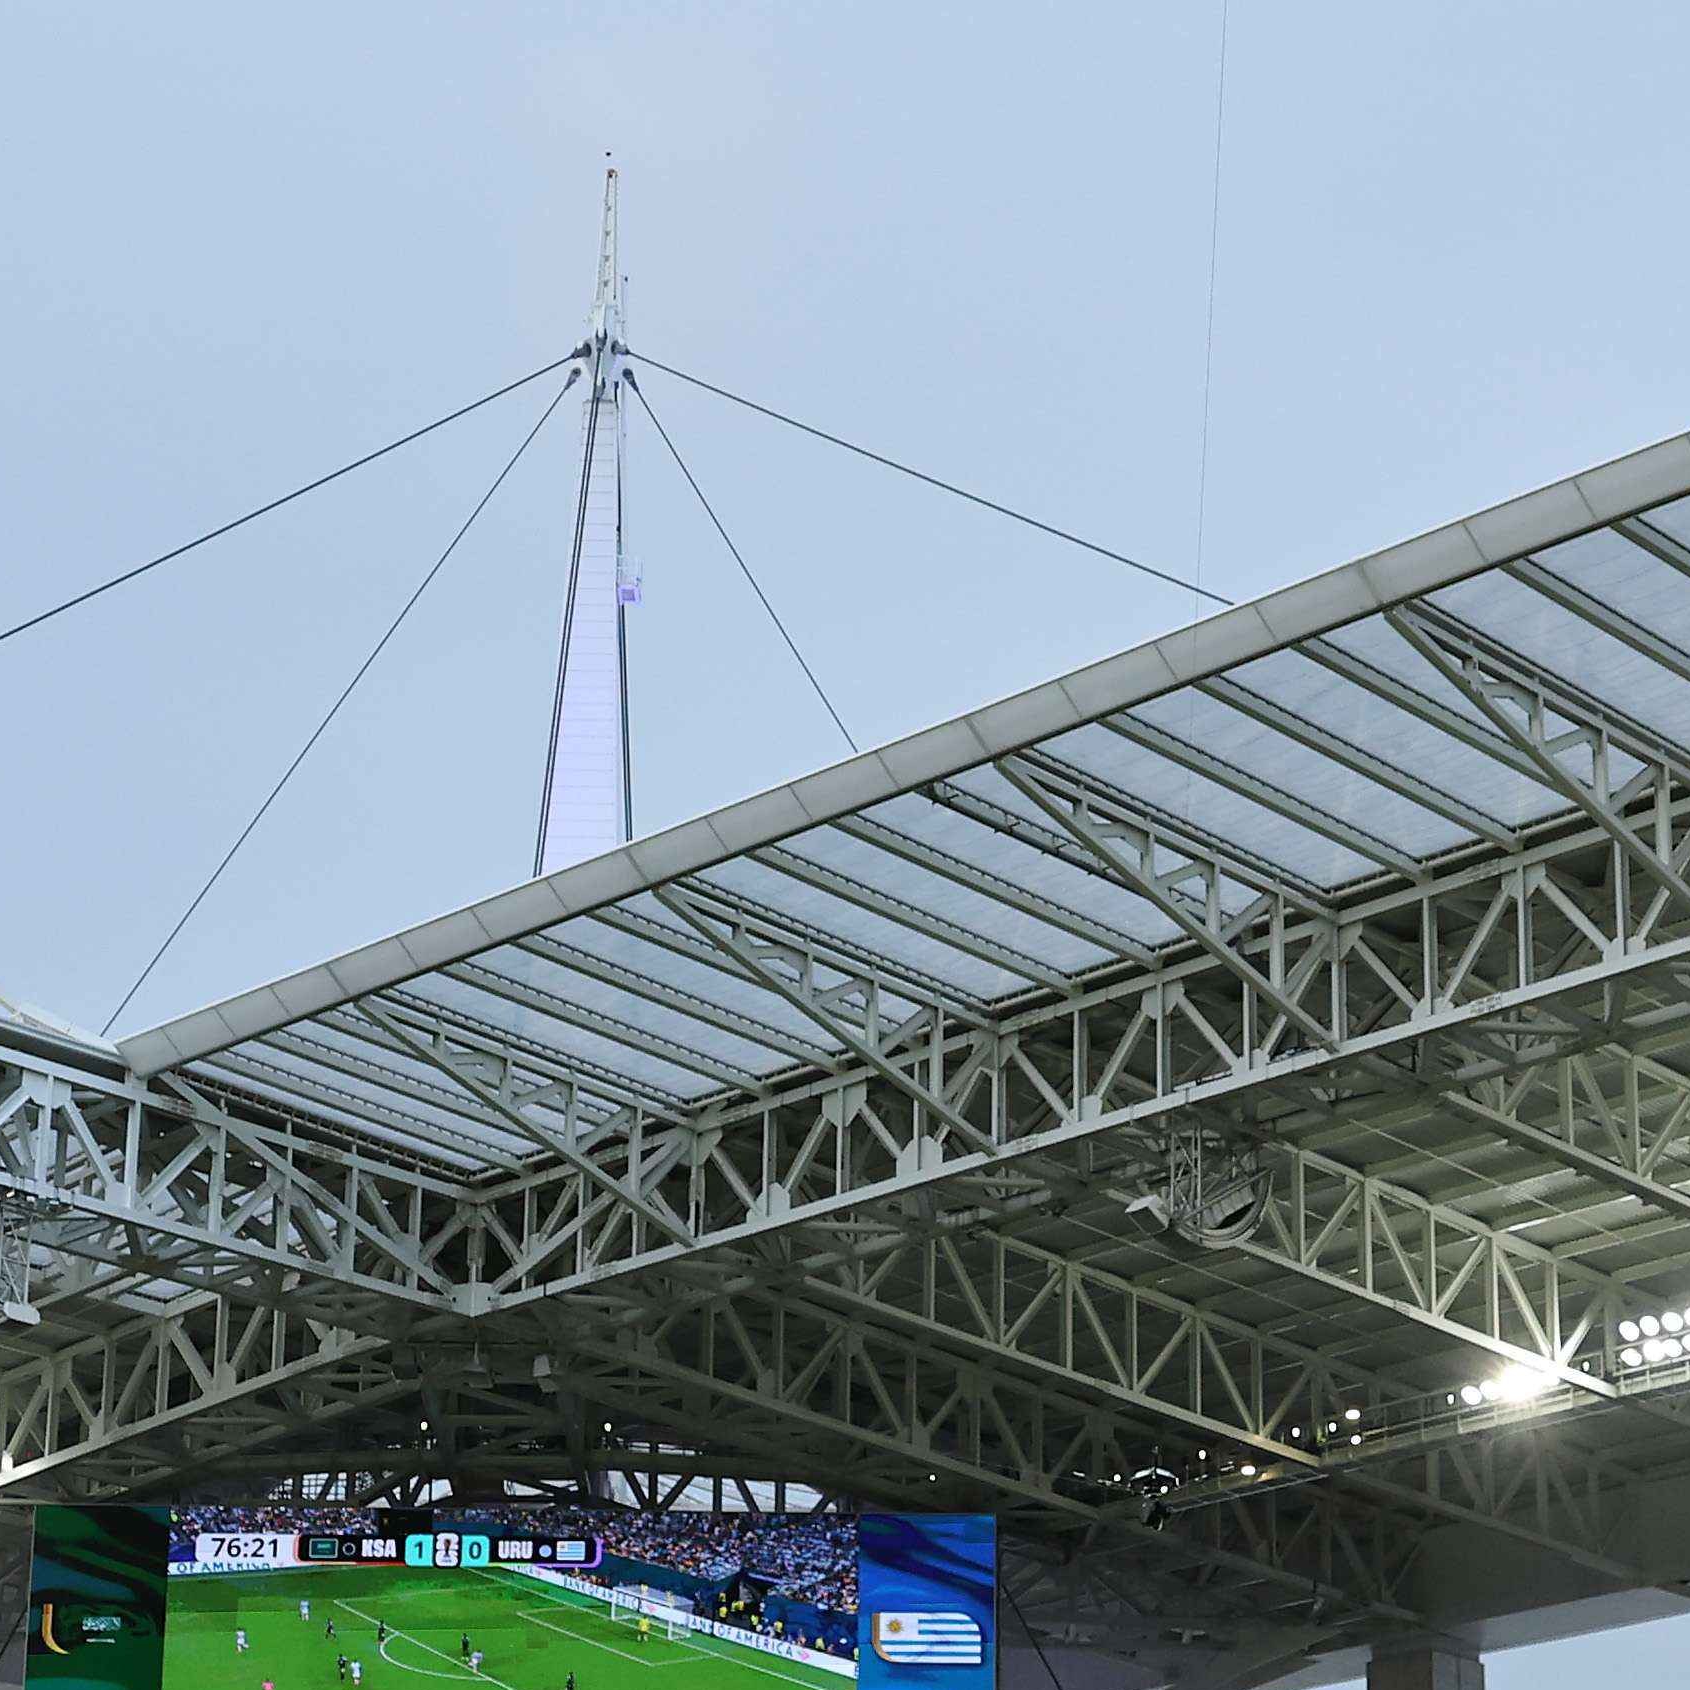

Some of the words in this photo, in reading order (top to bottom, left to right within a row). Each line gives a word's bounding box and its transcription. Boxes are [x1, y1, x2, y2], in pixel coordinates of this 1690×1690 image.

[211, 1537, 279, 1558] 76:21
[361, 1540, 398, 1558] KSA
[413, 1540, 425, 1559] 1
[468, 1541, 482, 1560] 0
[498, 1540, 533, 1560] URU
